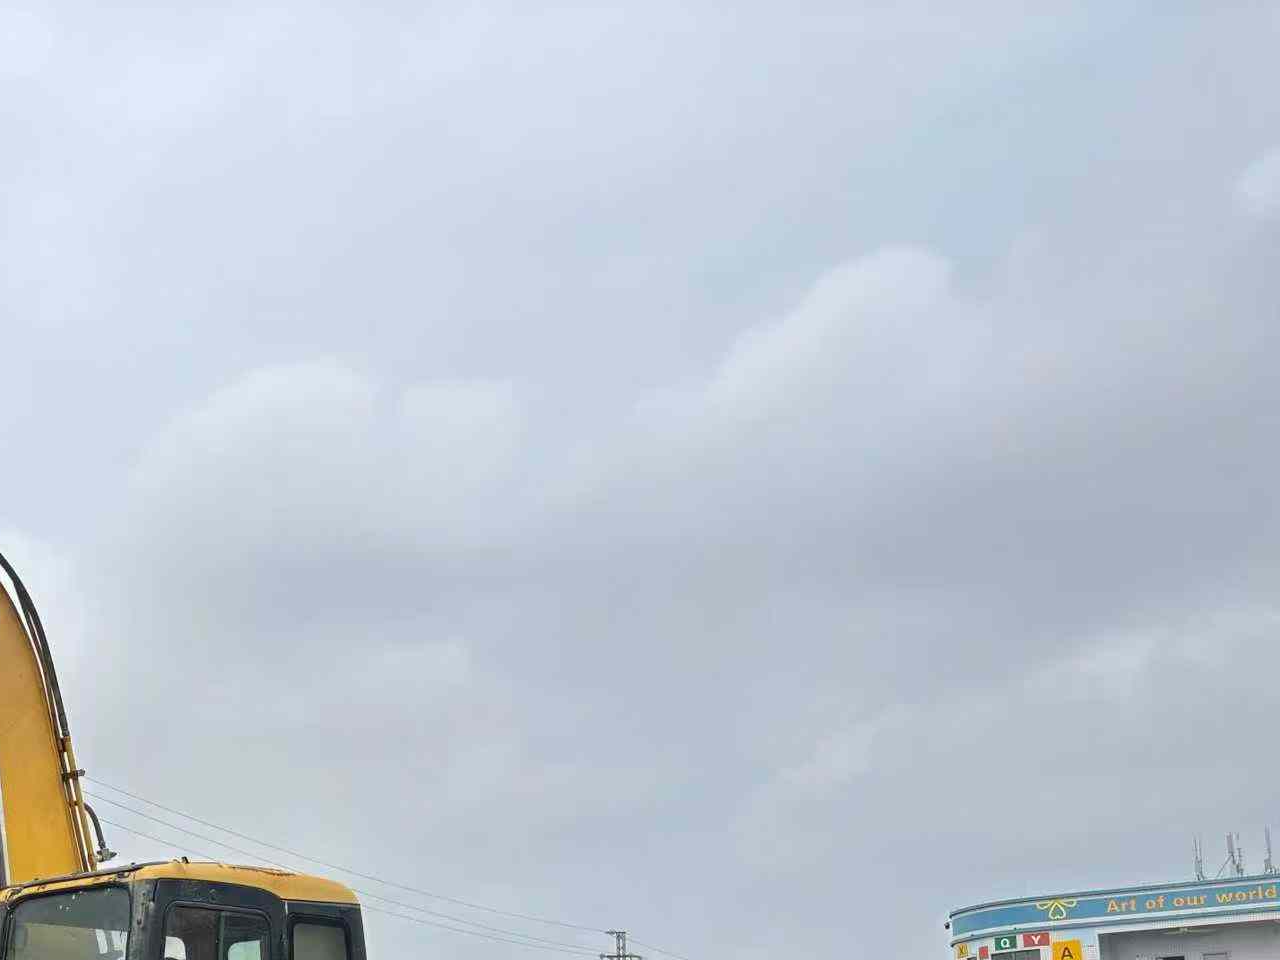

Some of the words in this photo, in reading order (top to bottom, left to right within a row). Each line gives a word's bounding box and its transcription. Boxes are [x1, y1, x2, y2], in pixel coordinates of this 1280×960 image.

[1107, 898, 1137, 912] Art
[1145, 895, 1165, 910] of
[1173, 895, 1207, 907] our
[1216, 885, 1277, 903] world
[1031, 935, 1041, 945] Y
[1061, 946, 1074, 960] A
